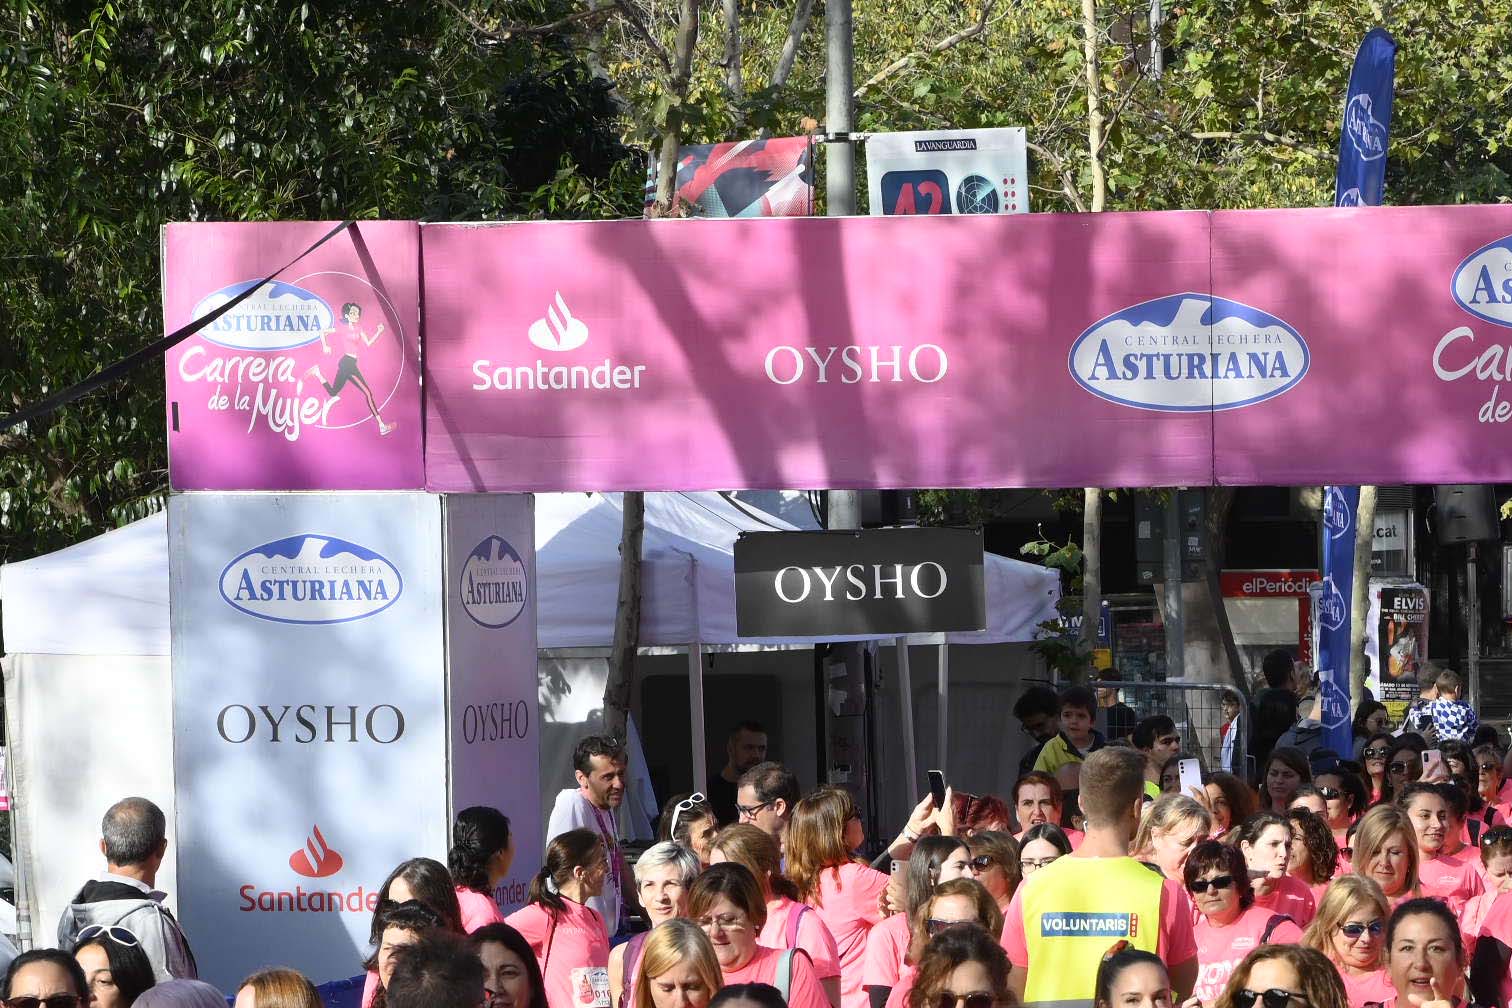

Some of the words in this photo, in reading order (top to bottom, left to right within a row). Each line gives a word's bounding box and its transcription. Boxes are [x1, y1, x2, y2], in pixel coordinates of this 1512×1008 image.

[1125, 335, 1200, 347] CENTRAL
[1207, 333, 1284, 345] LECHERA
[178, 345, 297, 384] Carrera
[472, 359, 646, 391] Santander
[764, 343, 949, 385] OYSHO
[1088, 338, 1291, 381] ASTURIANA
[207, 385, 230, 411] de
[234, 384, 251, 410] la
[248, 380, 340, 442] Mujer
[1478, 384, 1512, 424] de
[234, 568, 389, 602] ASTURIANA
[262, 565, 321, 574] CENTRAL
[326, 565, 383, 575] LECHERA
[466, 570, 523, 604] ASTURIANA
[774, 561, 948, 603] OYSHO
[1243, 577, 1312, 593] elPeriódi
[1394, 597, 1424, 610] ELVIS
[217, 704, 405, 744] OYSHO
[464, 700, 529, 744] OYSHO
[239, 885, 378, 913] Santande
[1043, 918, 1127, 931] VOLUNTARIS
